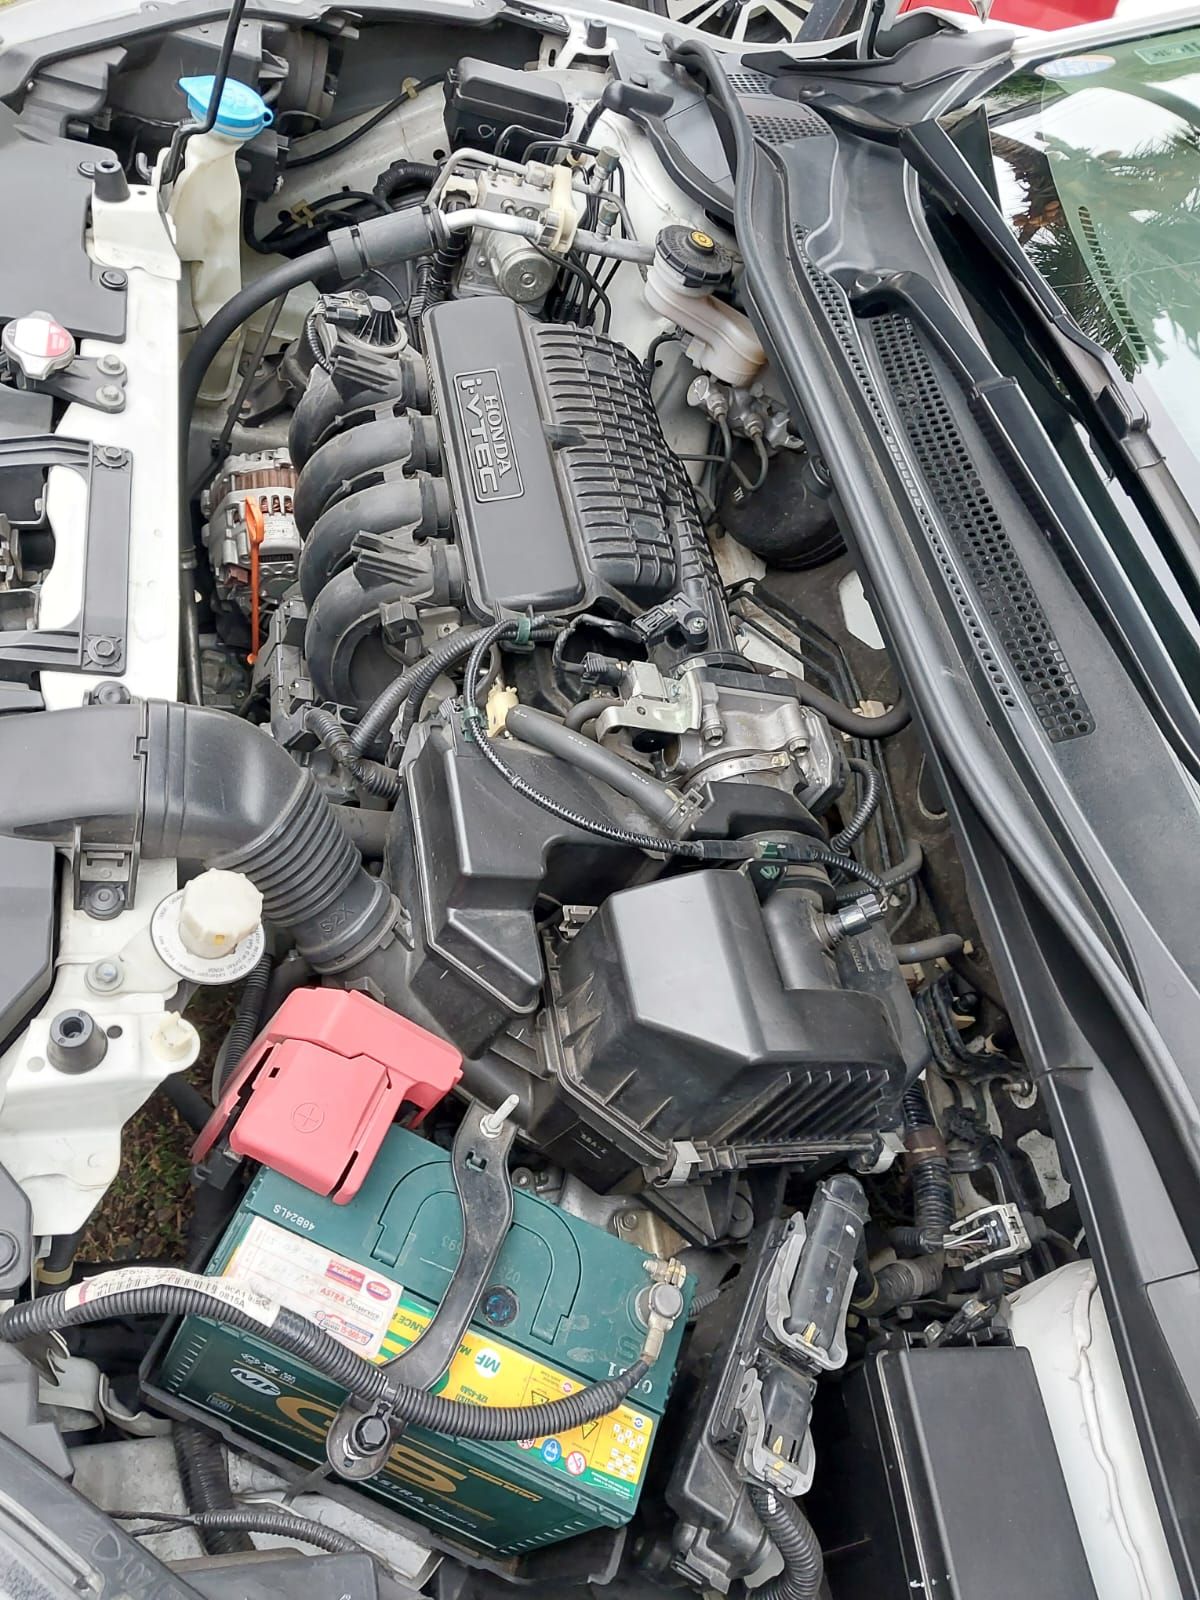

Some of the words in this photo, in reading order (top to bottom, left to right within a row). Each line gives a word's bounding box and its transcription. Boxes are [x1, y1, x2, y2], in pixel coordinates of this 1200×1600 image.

[482, 393, 512, 477] HONDA
[272, 1203, 314, 1231] 46B24LS
[319, 1286, 345, 1304] ASTRA
[475, 1354, 500, 1374] MF
[232, 1370, 279, 1393] MF
